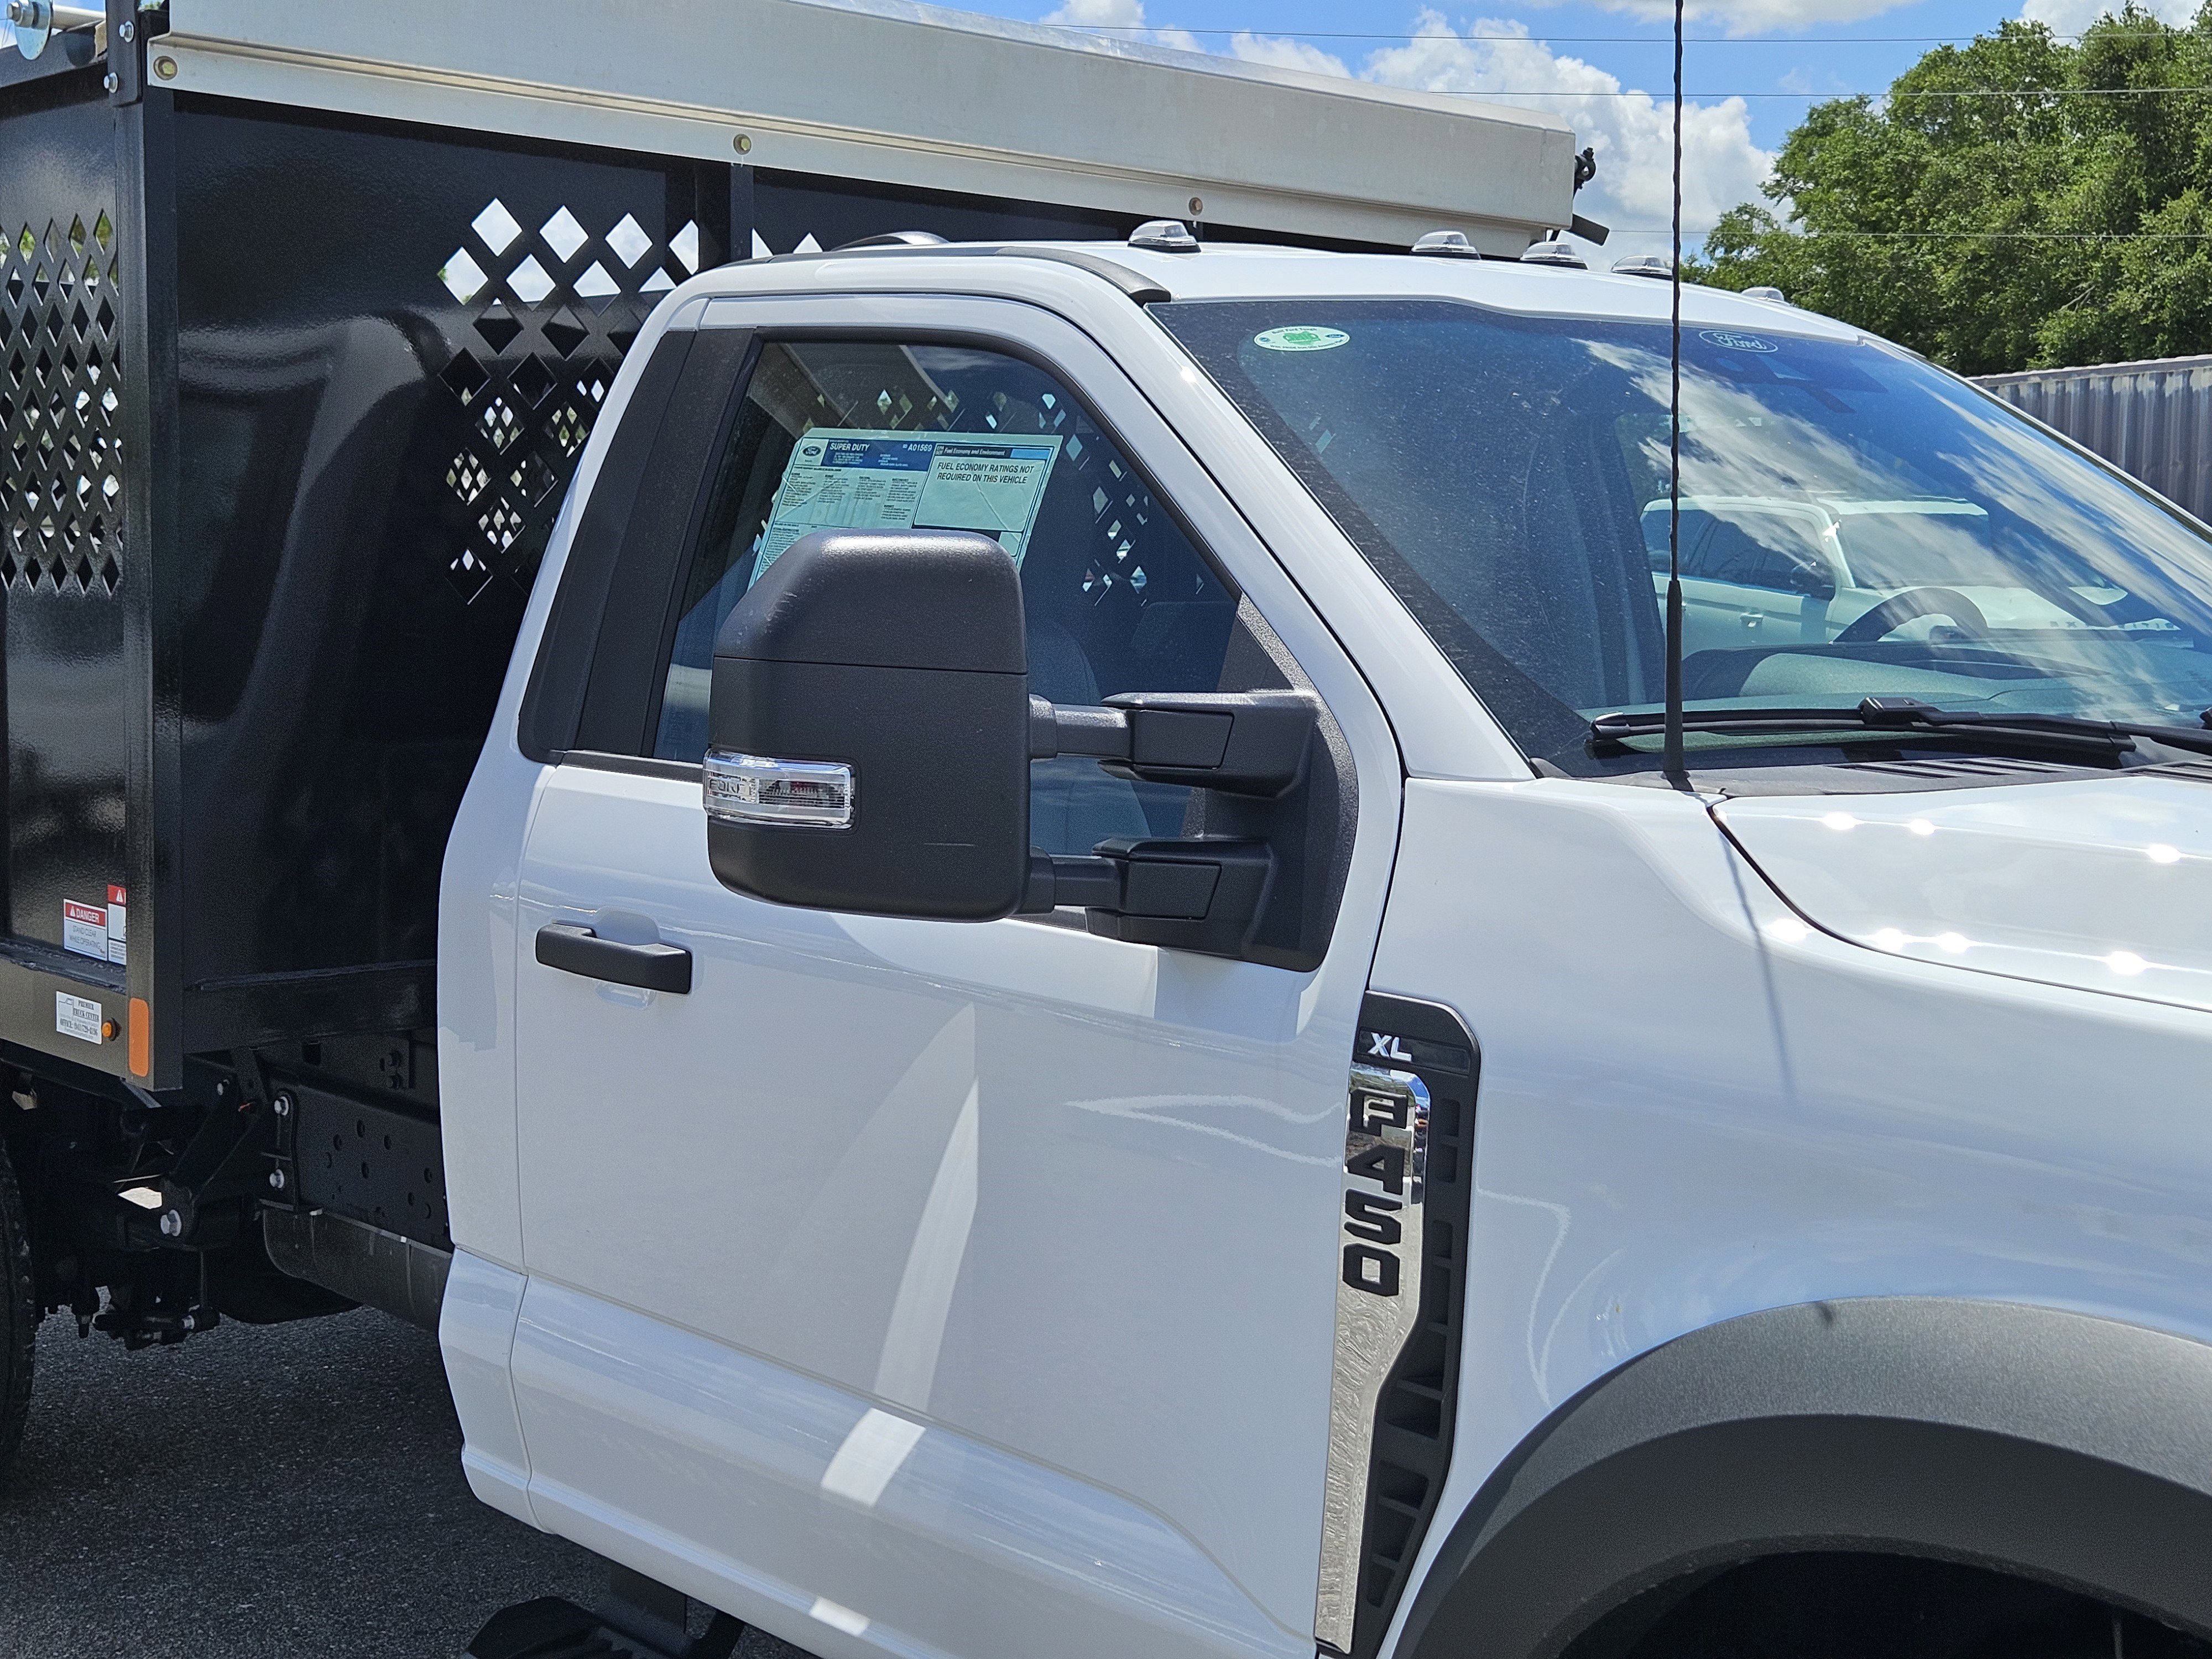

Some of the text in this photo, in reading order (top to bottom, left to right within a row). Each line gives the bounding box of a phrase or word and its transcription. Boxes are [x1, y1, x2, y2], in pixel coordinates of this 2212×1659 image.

[1712, 332, 1767, 349] Ford
[830, 442, 870, 451] SUPER DUTY
[907, 444, 933, 452] A01569
[955, 463, 989, 472] ECONOMY
[989, 465, 1018, 473] RATINGS
[1019, 465, 1035, 473] NOT
[937, 472, 1027, 484] REQUIRED ON THIS VEHICLE
[76, 908, 100, 923] DANGER
[85, 1011, 99, 1021] CENTER
[1367, 1032, 1412, 1062] XL
[1342, 1089, 1408, 1297] F450
